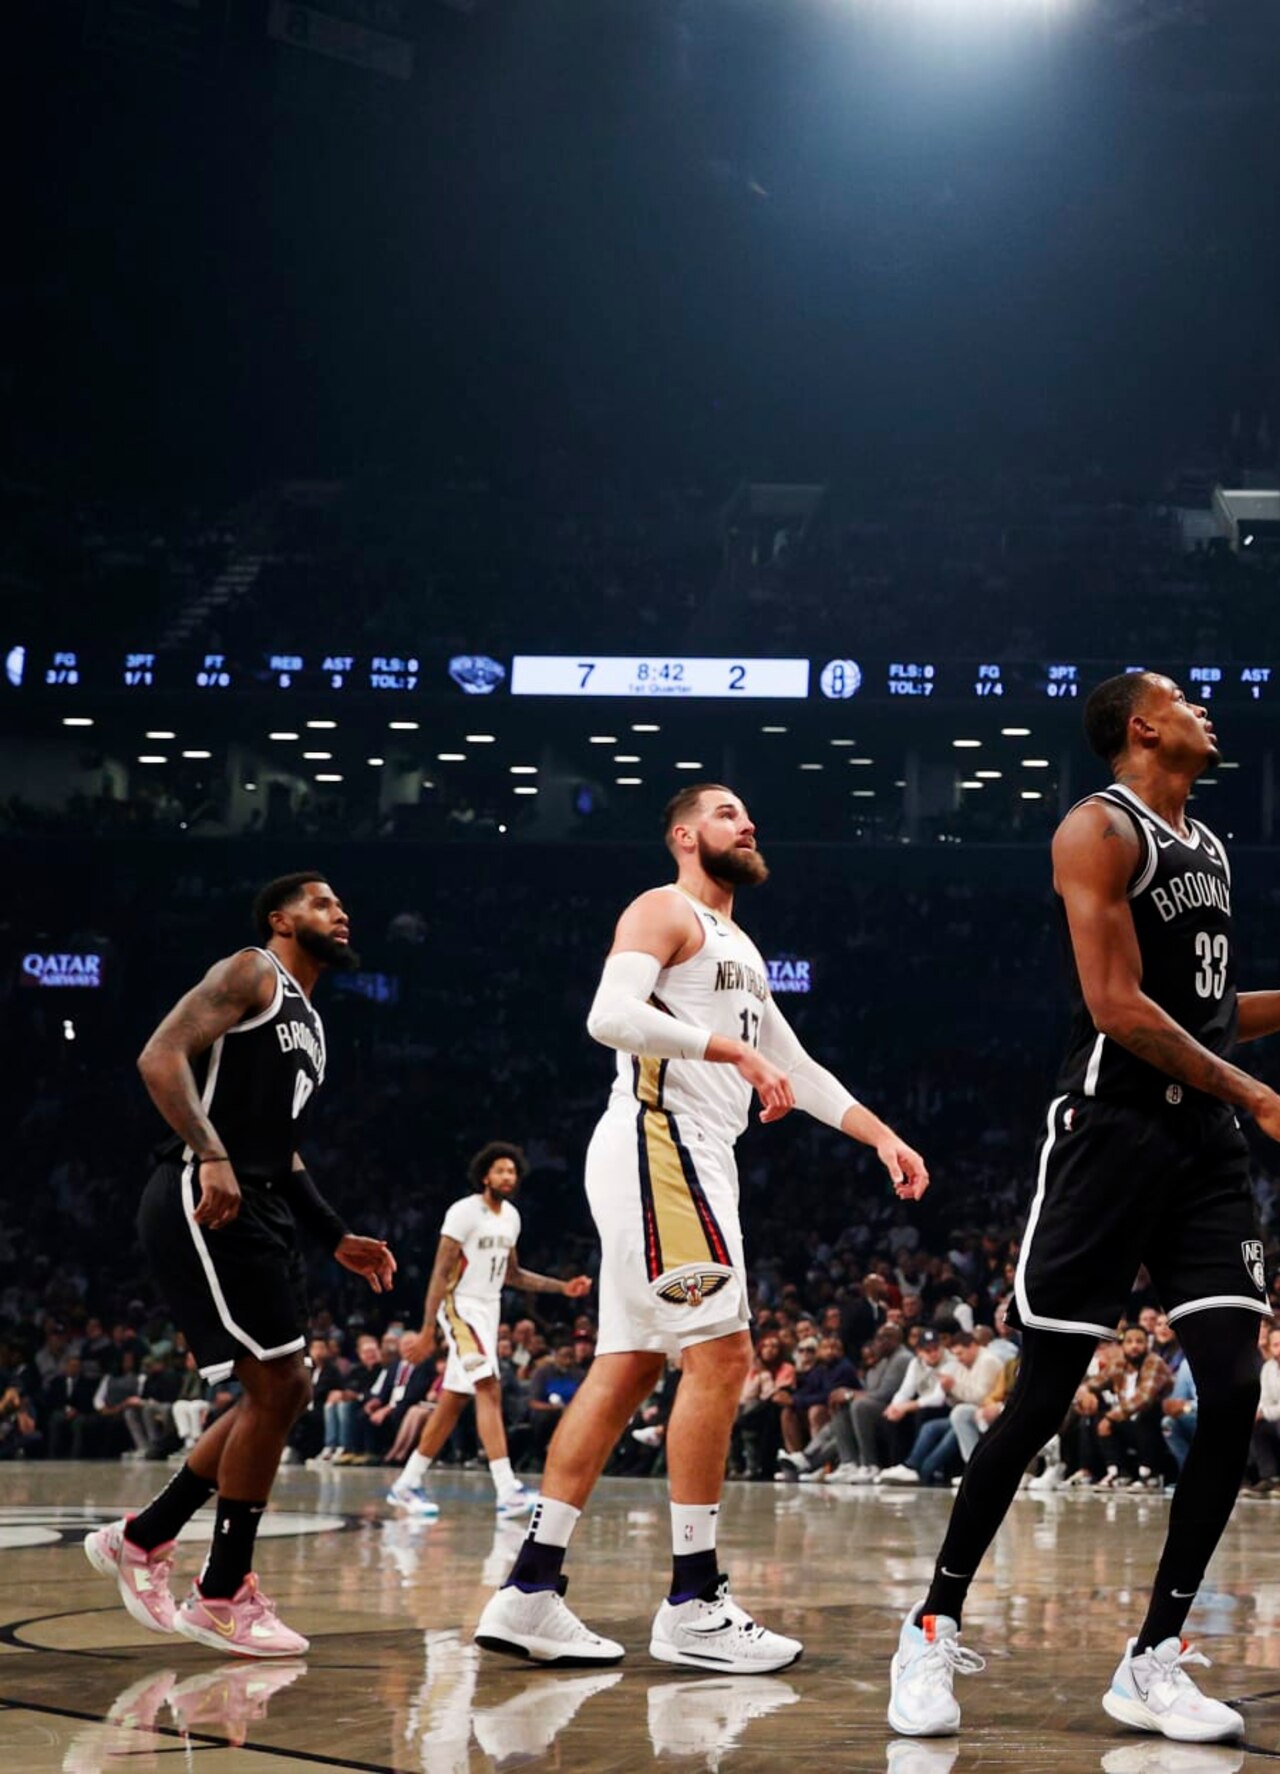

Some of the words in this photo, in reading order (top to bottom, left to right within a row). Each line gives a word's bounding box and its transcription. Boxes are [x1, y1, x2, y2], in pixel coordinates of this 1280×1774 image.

[54, 653, 76, 667] FG
[204, 655, 225, 669] FT
[322, 656, 354, 671] AST
[125, 671, 152, 685] 1/1
[578, 664, 596, 688] 7
[637, 663, 684, 680] 8:42
[728, 665, 746, 690] 2
[979, 665, 999, 679] FG
[1048, 666, 1077, 680] 3PT
[1190, 668, 1221, 682] REB
[1241, 668, 1270, 682] AST
[975, 682, 1003, 696] 1/4
[1047, 683, 1078, 697] 0/1
[1201, 686, 1211, 698] 2
[1252, 686, 1259, 698] 1
[1151, 872, 1231, 922] BROOKLY
[22, 953, 101, 977] QATAR
[766, 960, 811, 980] TAR
[1195, 931, 1228, 1000] 33
[715, 960, 744, 992] NEW
[739, 1007, 759, 1049] 17
